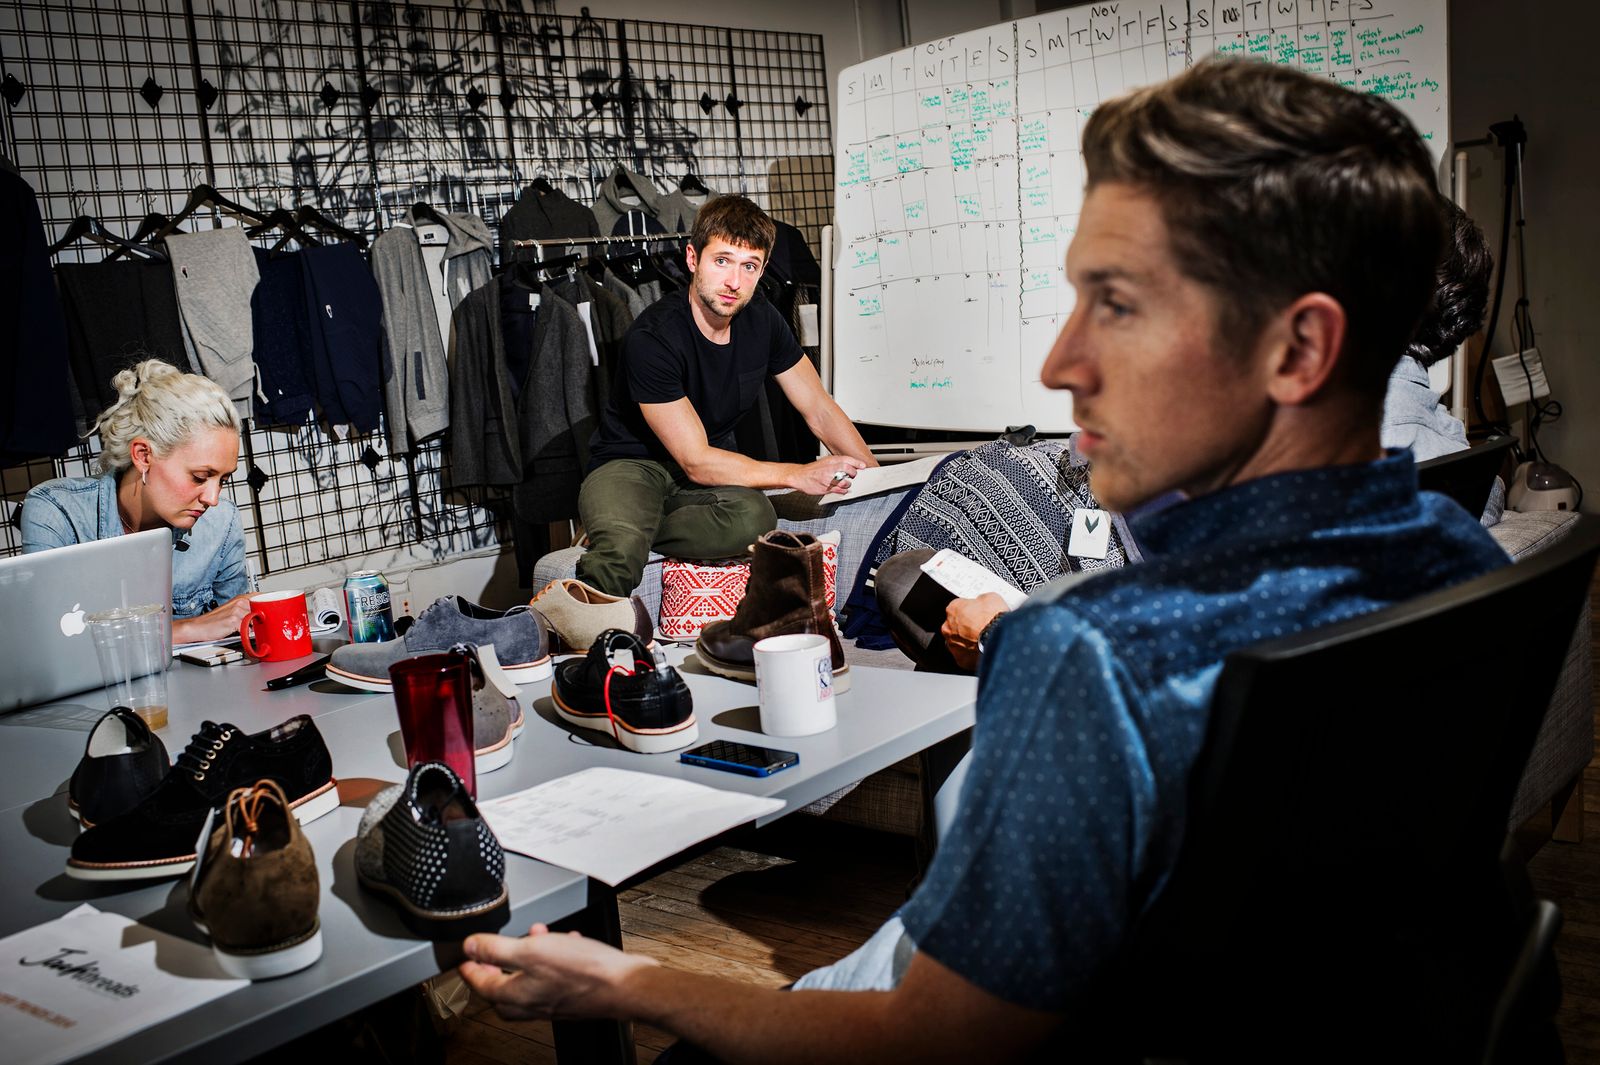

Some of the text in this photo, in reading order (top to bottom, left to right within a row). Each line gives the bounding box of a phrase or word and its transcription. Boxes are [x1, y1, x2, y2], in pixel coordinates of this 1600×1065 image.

[1198, 9, 1209, 28] S
[1246, 1, 1261, 20] T
[1277, 1, 1293, 14] W
[926, 37, 955, 55] OCT
[1024, 16, 1178, 58] S M T W T F S
[848, 82, 857, 95] S
[903, 67, 911, 80] T
[925, 64, 936, 78] W
[950, 56, 959, 73] T
[971, 50, 983, 66] F
[996, 45, 1009, 63] S
[354, 591, 390, 608] FRESC
